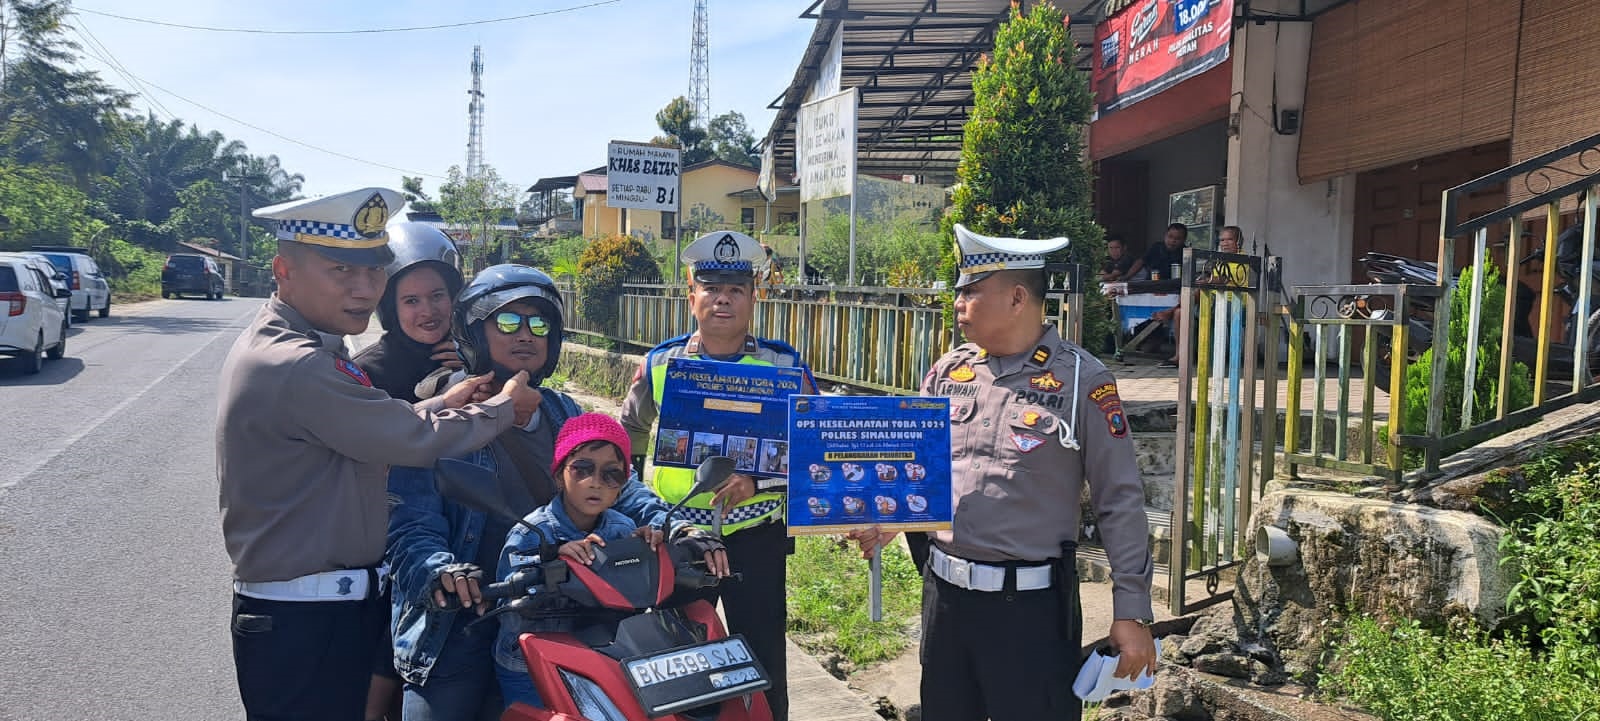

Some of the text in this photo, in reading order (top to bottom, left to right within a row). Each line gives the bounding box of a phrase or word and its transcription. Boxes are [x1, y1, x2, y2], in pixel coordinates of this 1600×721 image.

[618, 147, 645, 157] RUMAH
[609, 156, 679, 176] KHAS BATAK
[1014, 389, 1064, 409] POLRI
[796, 419, 945, 429] OPS KESELAMATAN TOBA 2024
[821, 431, 923, 440] POLRES SIMALUNGUN
[712, 643, 749, 666] SAJ
